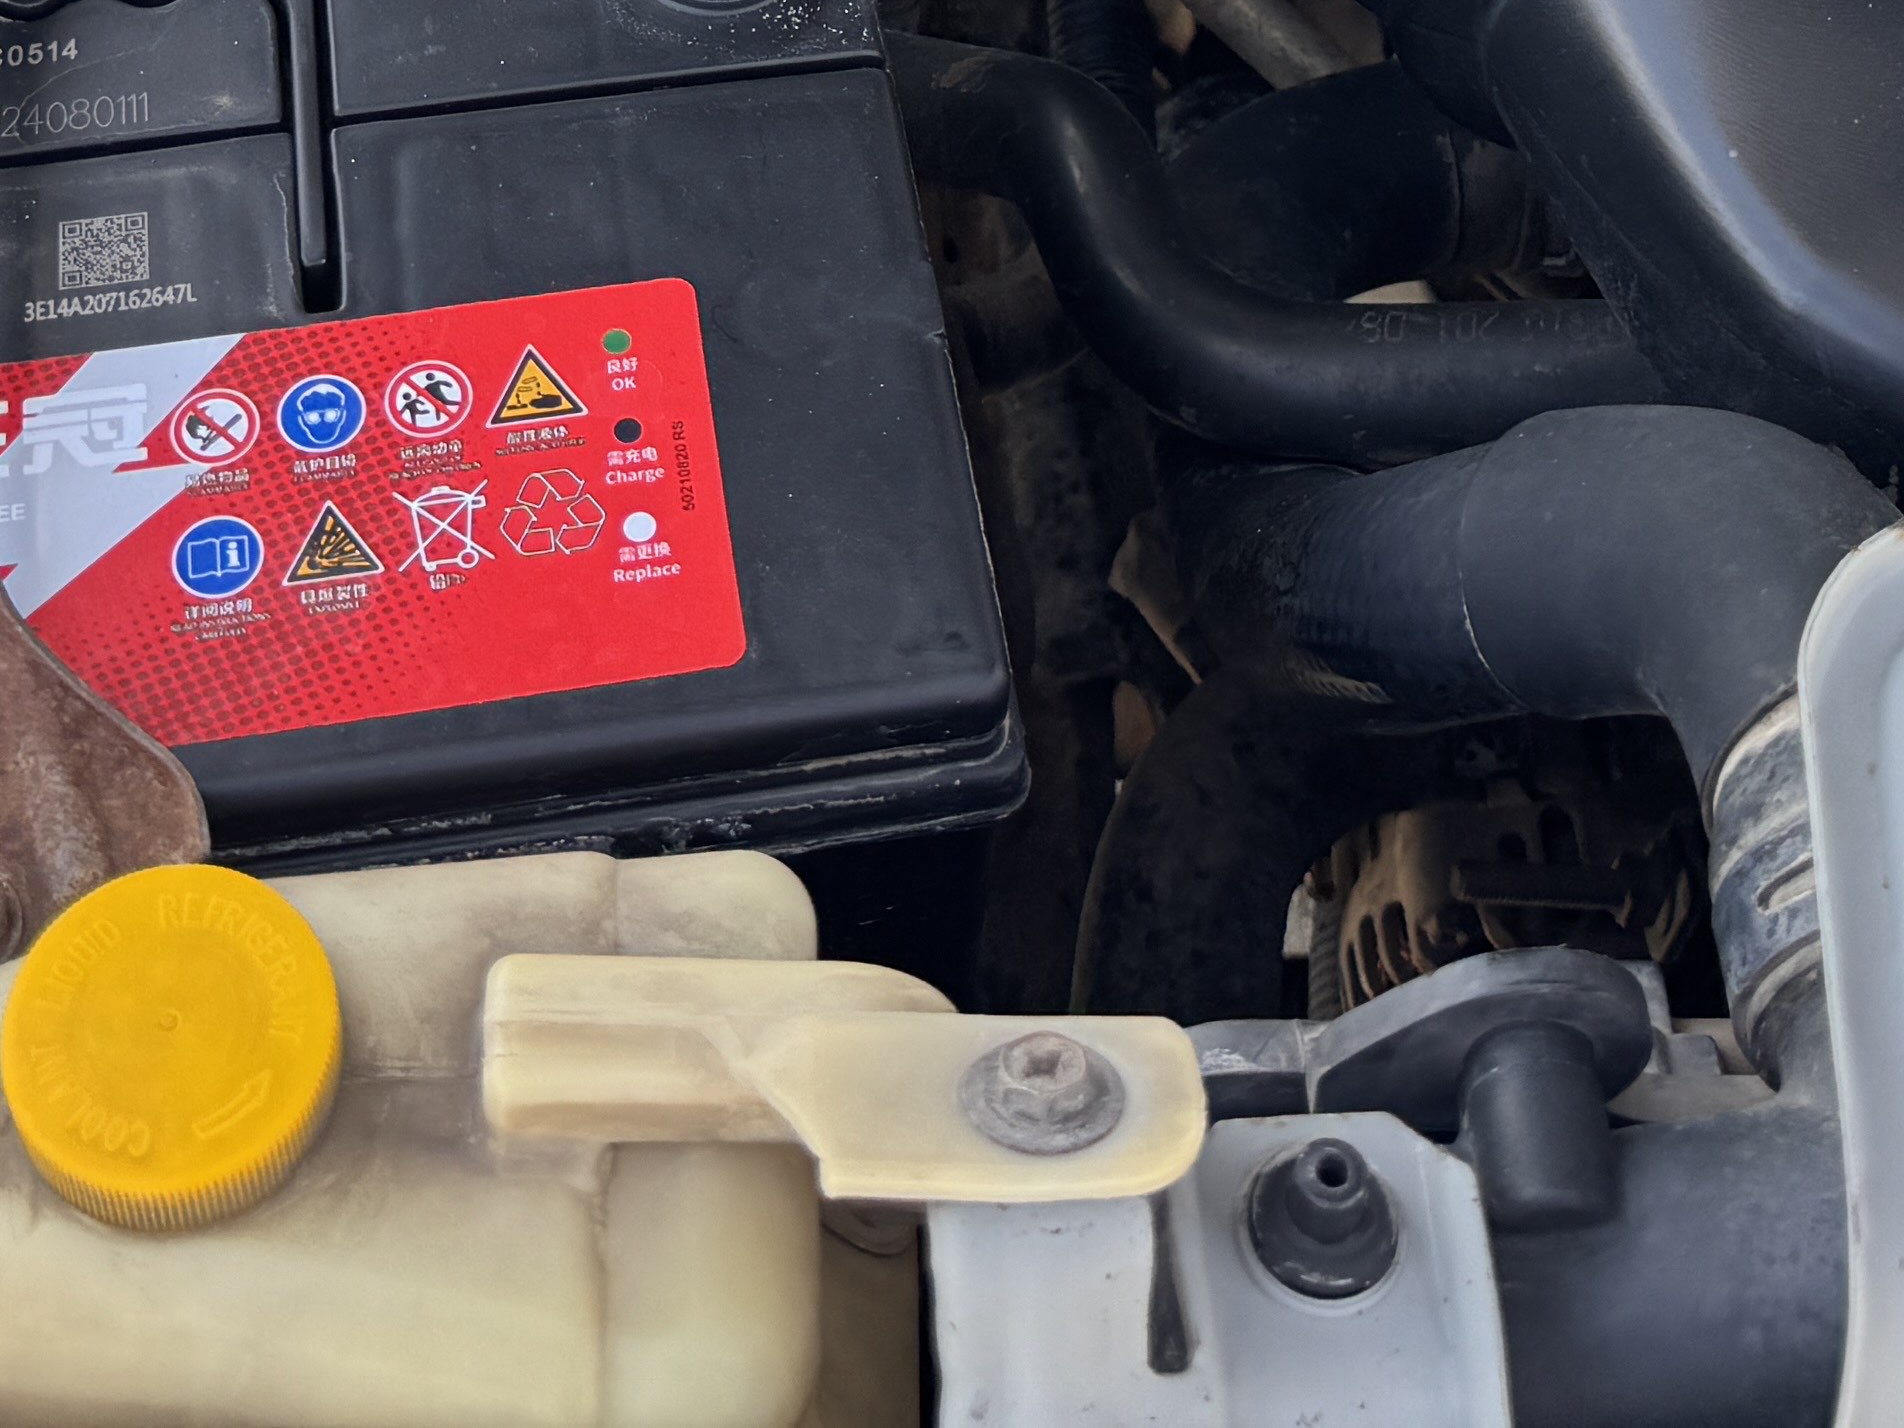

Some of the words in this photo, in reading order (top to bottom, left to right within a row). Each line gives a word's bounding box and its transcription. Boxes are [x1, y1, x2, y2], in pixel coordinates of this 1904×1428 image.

[607, 357, 639, 374] 良好
[611, 377, 636, 391] OK
[607, 446, 658, 466] 需充电
[605, 467, 665, 485] Charge
[619, 542, 672, 563] 需更换
[613, 562, 681, 583] Replace
